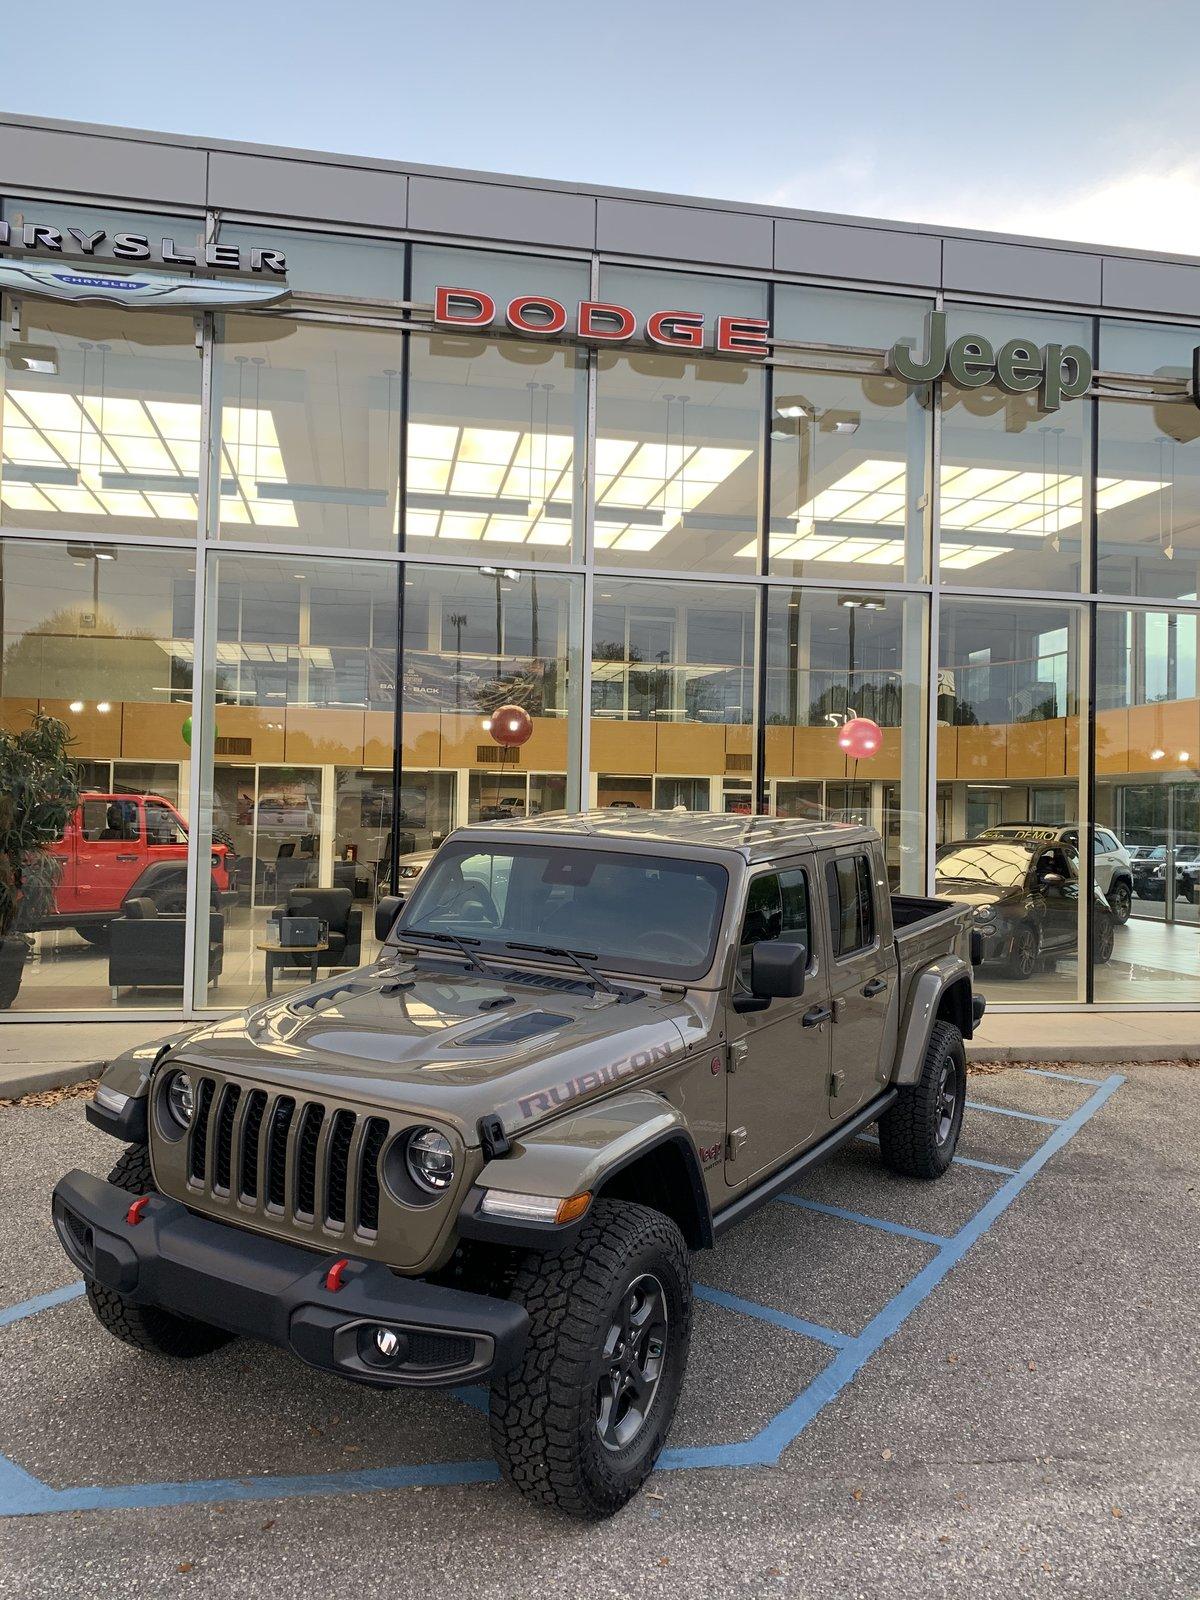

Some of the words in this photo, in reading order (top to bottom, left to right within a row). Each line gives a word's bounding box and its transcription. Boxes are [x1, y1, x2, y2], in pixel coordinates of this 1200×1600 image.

[62, 277, 137, 288] CHRYSLER
[434, 286, 770, 355] DODGE
[888, 310, 1093, 412] Jeep
[1014, 831, 1055, 841] DEMO
[516, 1041, 674, 1119] RUBICON
